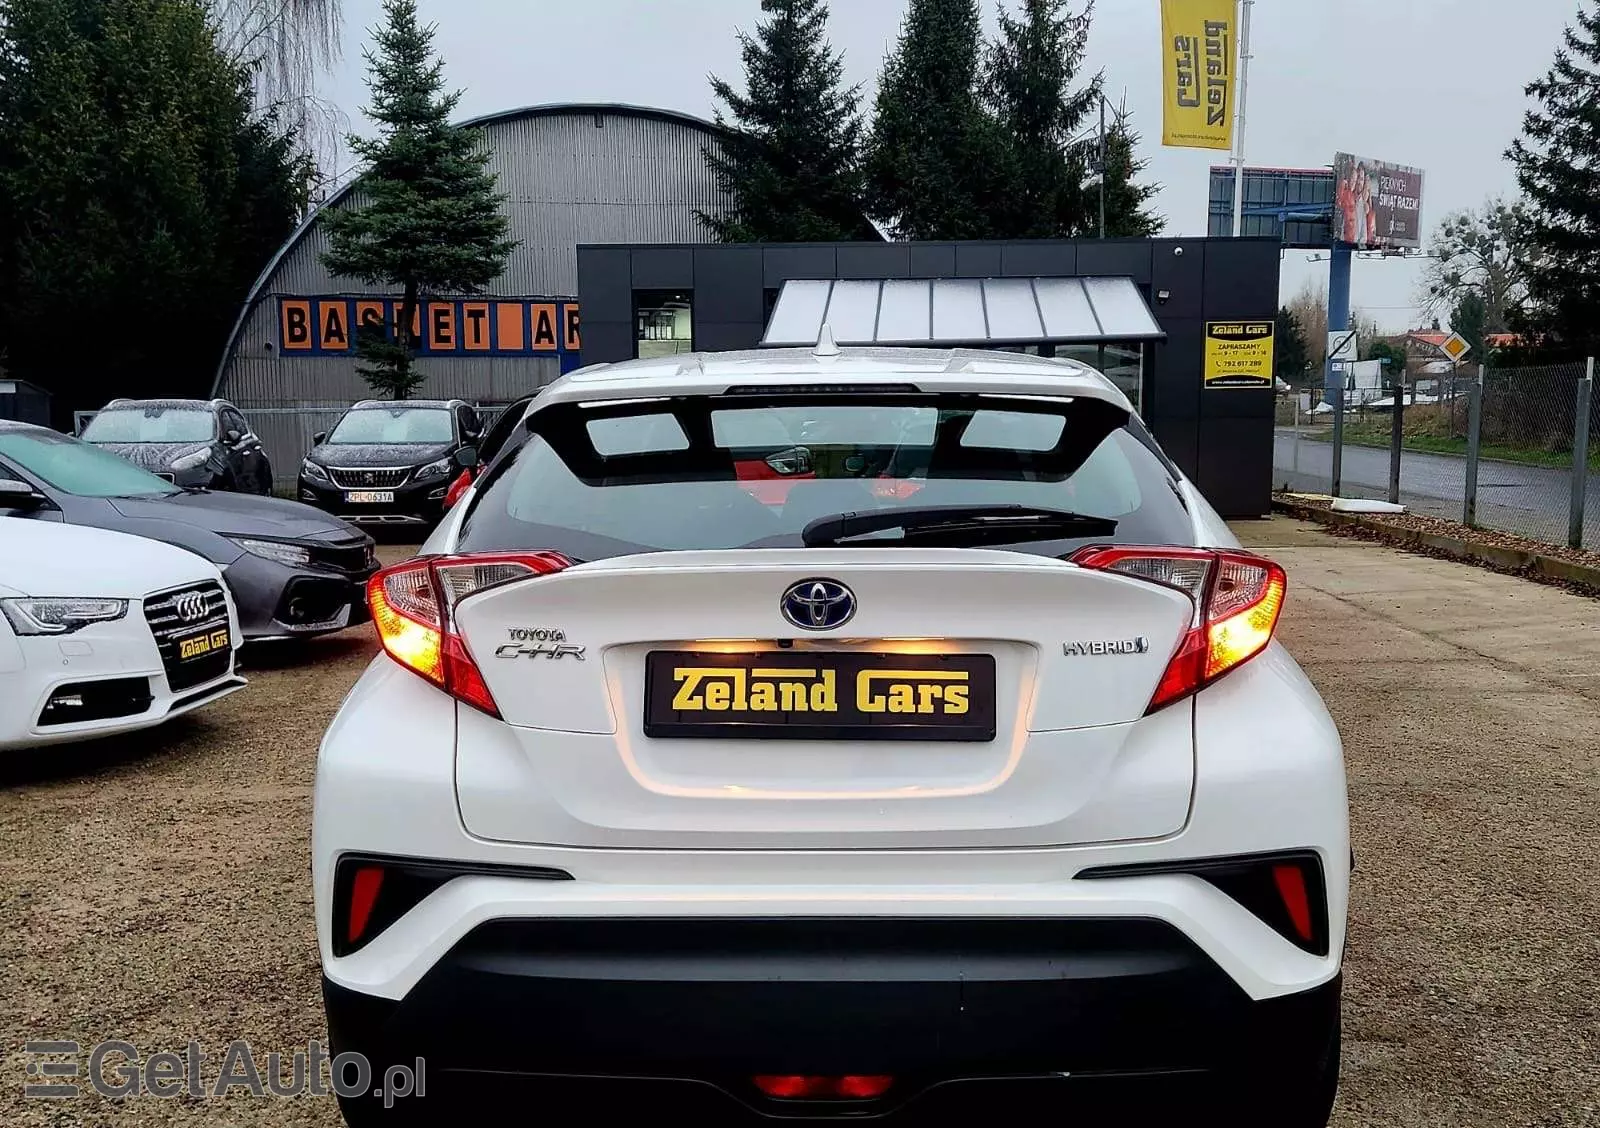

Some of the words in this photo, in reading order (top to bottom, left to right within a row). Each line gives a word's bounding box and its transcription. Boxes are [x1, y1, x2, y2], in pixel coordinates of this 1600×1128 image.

[1212, 325, 1243, 335] Zeland
[1246, 325, 1268, 334] Cars
[508, 627, 567, 642] TOYOTA
[179, 634, 210, 659] Zeland
[210, 629, 228, 649] Cars
[494, 642, 586, 661] C-HR
[1062, 640, 1136, 656] HYBRID
[672, 667, 838, 712] Zeland
[856, 669, 969, 714] Cars
